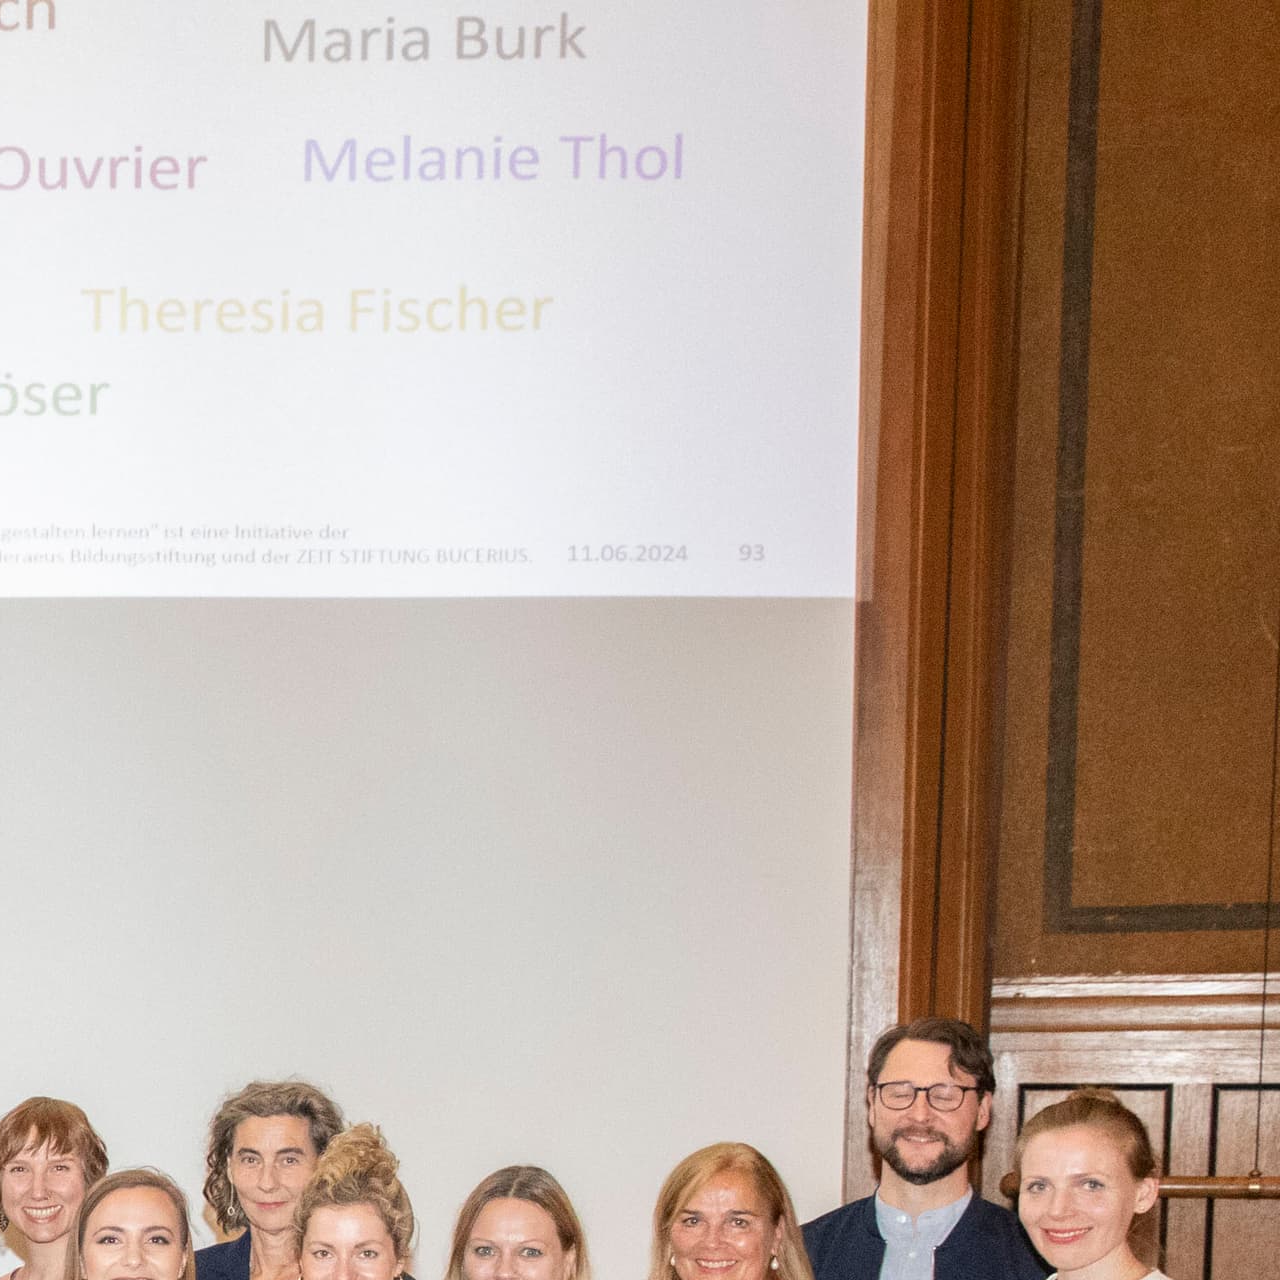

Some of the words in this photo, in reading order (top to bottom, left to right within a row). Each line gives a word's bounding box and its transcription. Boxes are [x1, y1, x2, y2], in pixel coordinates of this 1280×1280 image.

[262, 15, 431, 65] Maria
[454, 10, 587, 62] Burk
[303, 134, 541, 184] Melanie
[558, 132, 684, 182] Thol
[80, 286, 325, 334] Theresia
[349, 284, 554, 333] Fischer
[191, 524, 230, 540] eine
[235, 522, 313, 540] Initiative
[318, 522, 350, 540] der
[221, 548, 256, 565] und
[261, 548, 291, 565] der
[296, 547, 336, 565] ZEIT
[339, 547, 430, 565] STIFTUNG
[566, 543, 689, 563] 11.06.2024
[738, 543, 766, 563] 93
